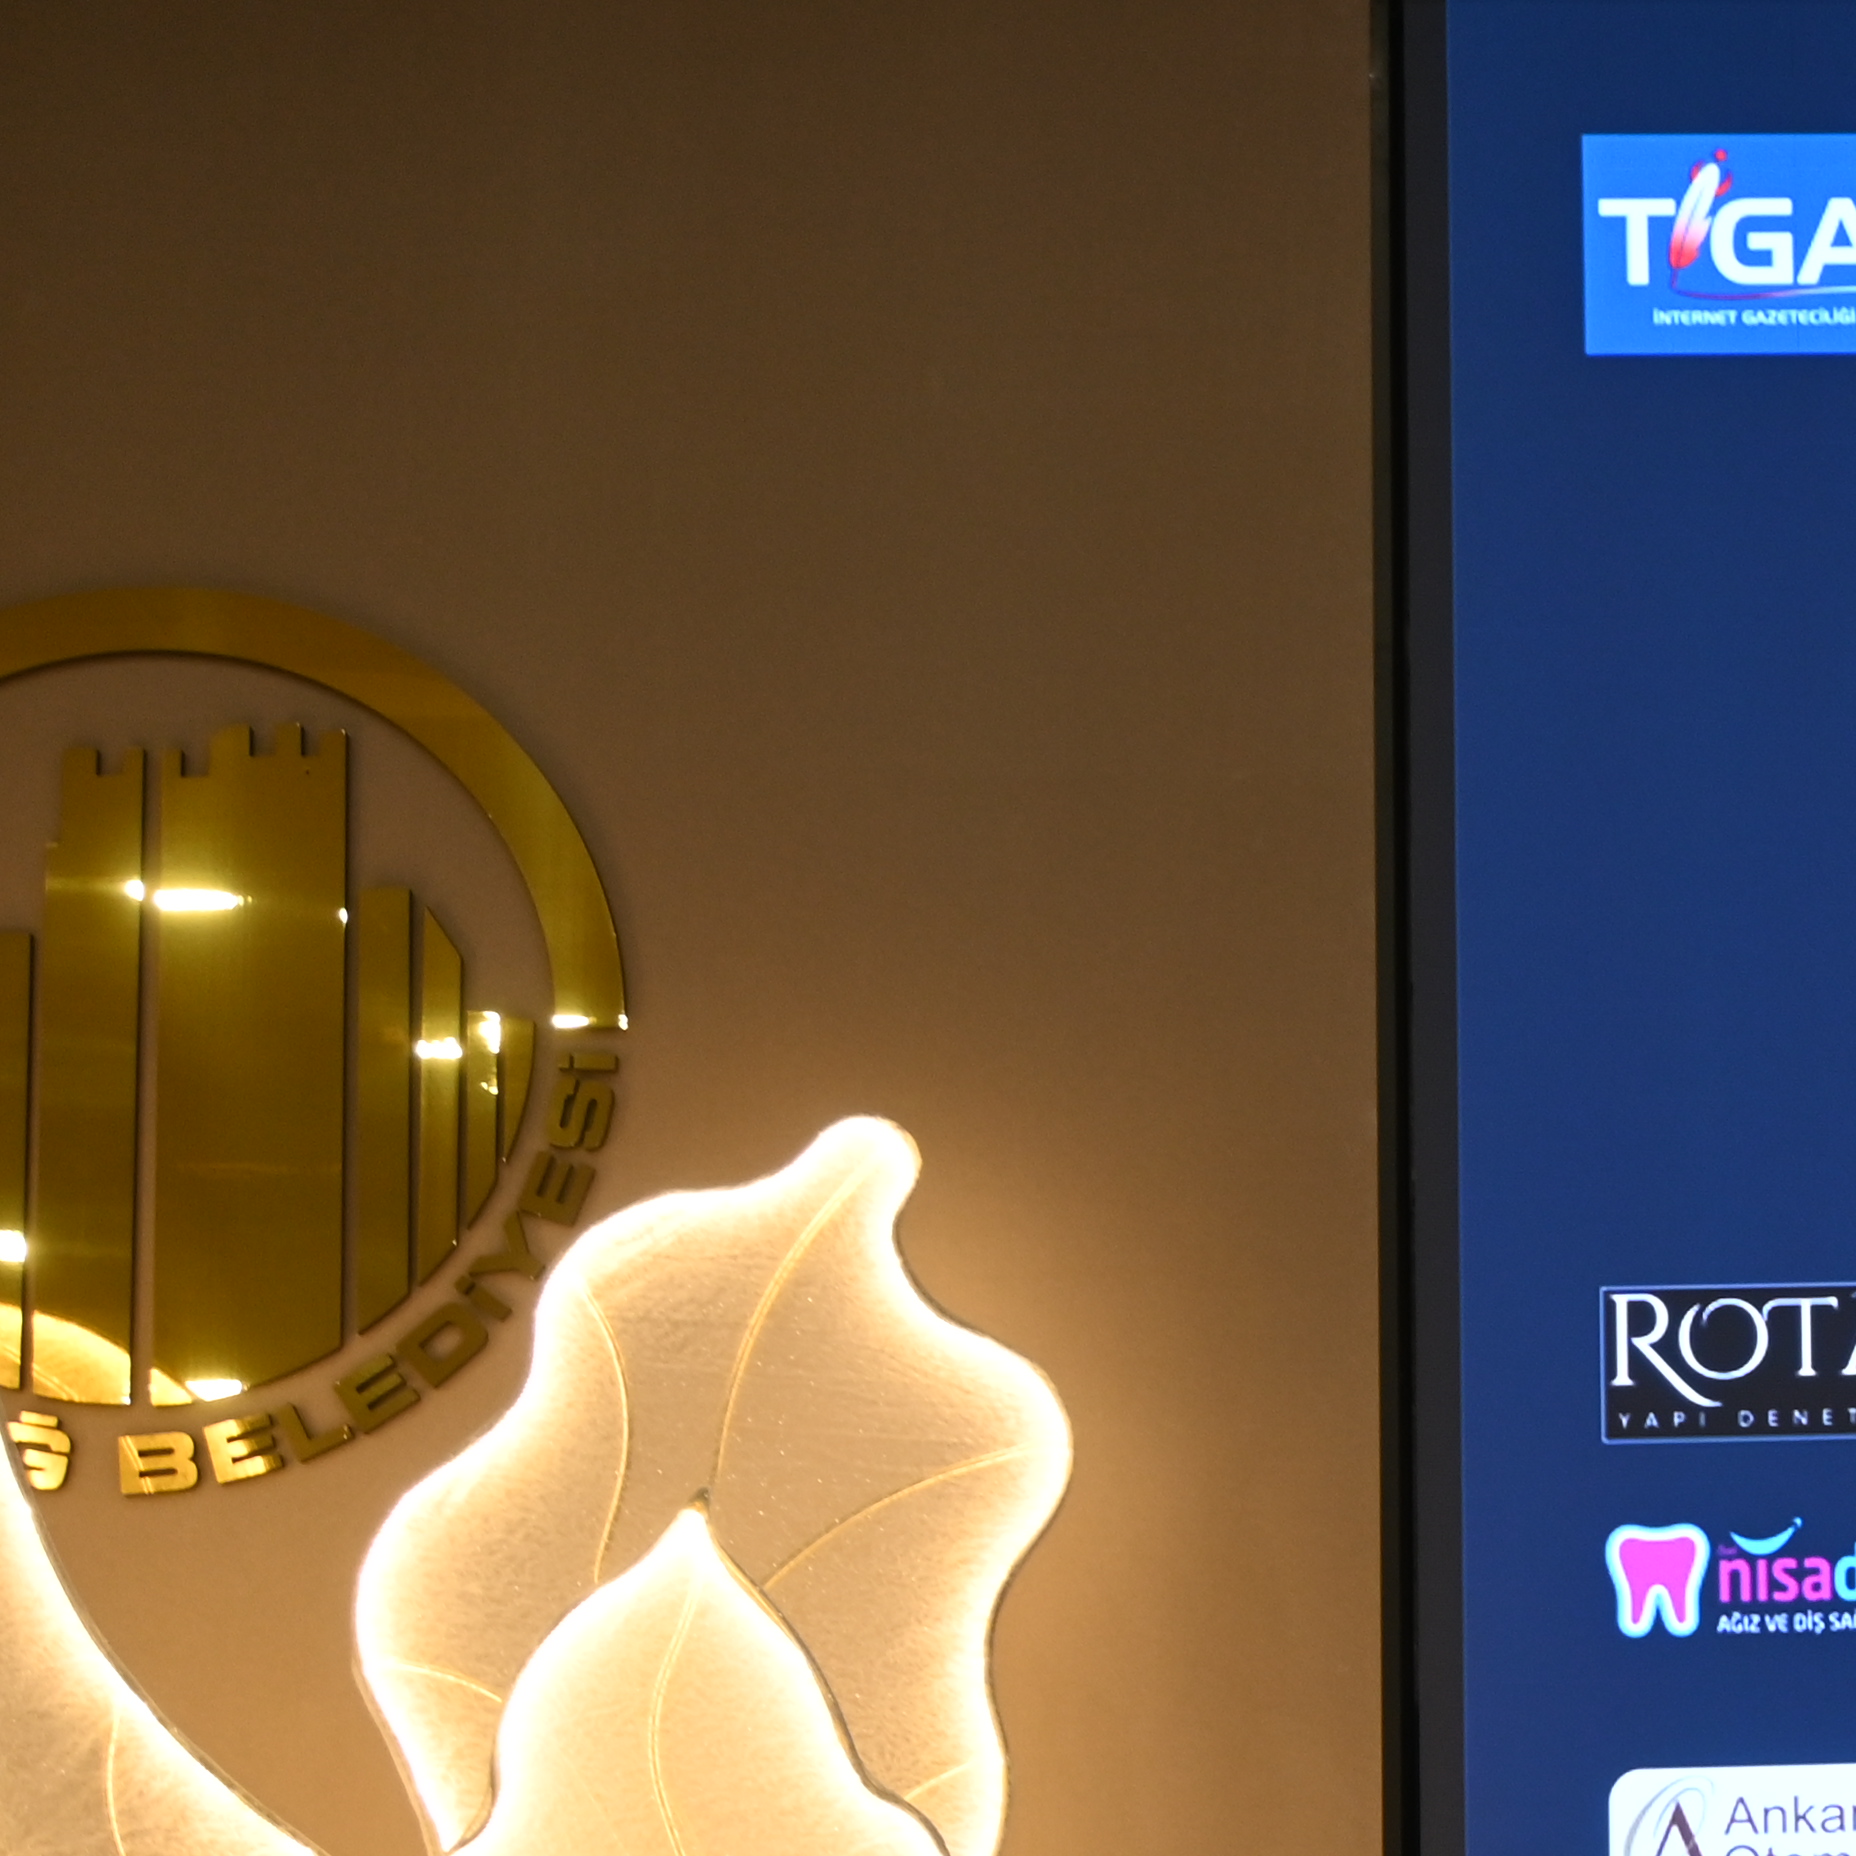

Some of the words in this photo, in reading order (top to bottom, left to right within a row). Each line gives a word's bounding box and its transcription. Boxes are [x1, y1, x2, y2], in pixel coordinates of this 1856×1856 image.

[1652, 306, 1738, 326] İNTERNET
[1741, 305, 1856, 326] GAZETECİLİĞİ
[1618, 1411, 1706, 1429] YAPI
[1716, 1610, 1762, 1634] AĞIZ
[1765, 1612, 1789, 1632] VE
[1793, 1608, 1825, 1635] DİŞ
